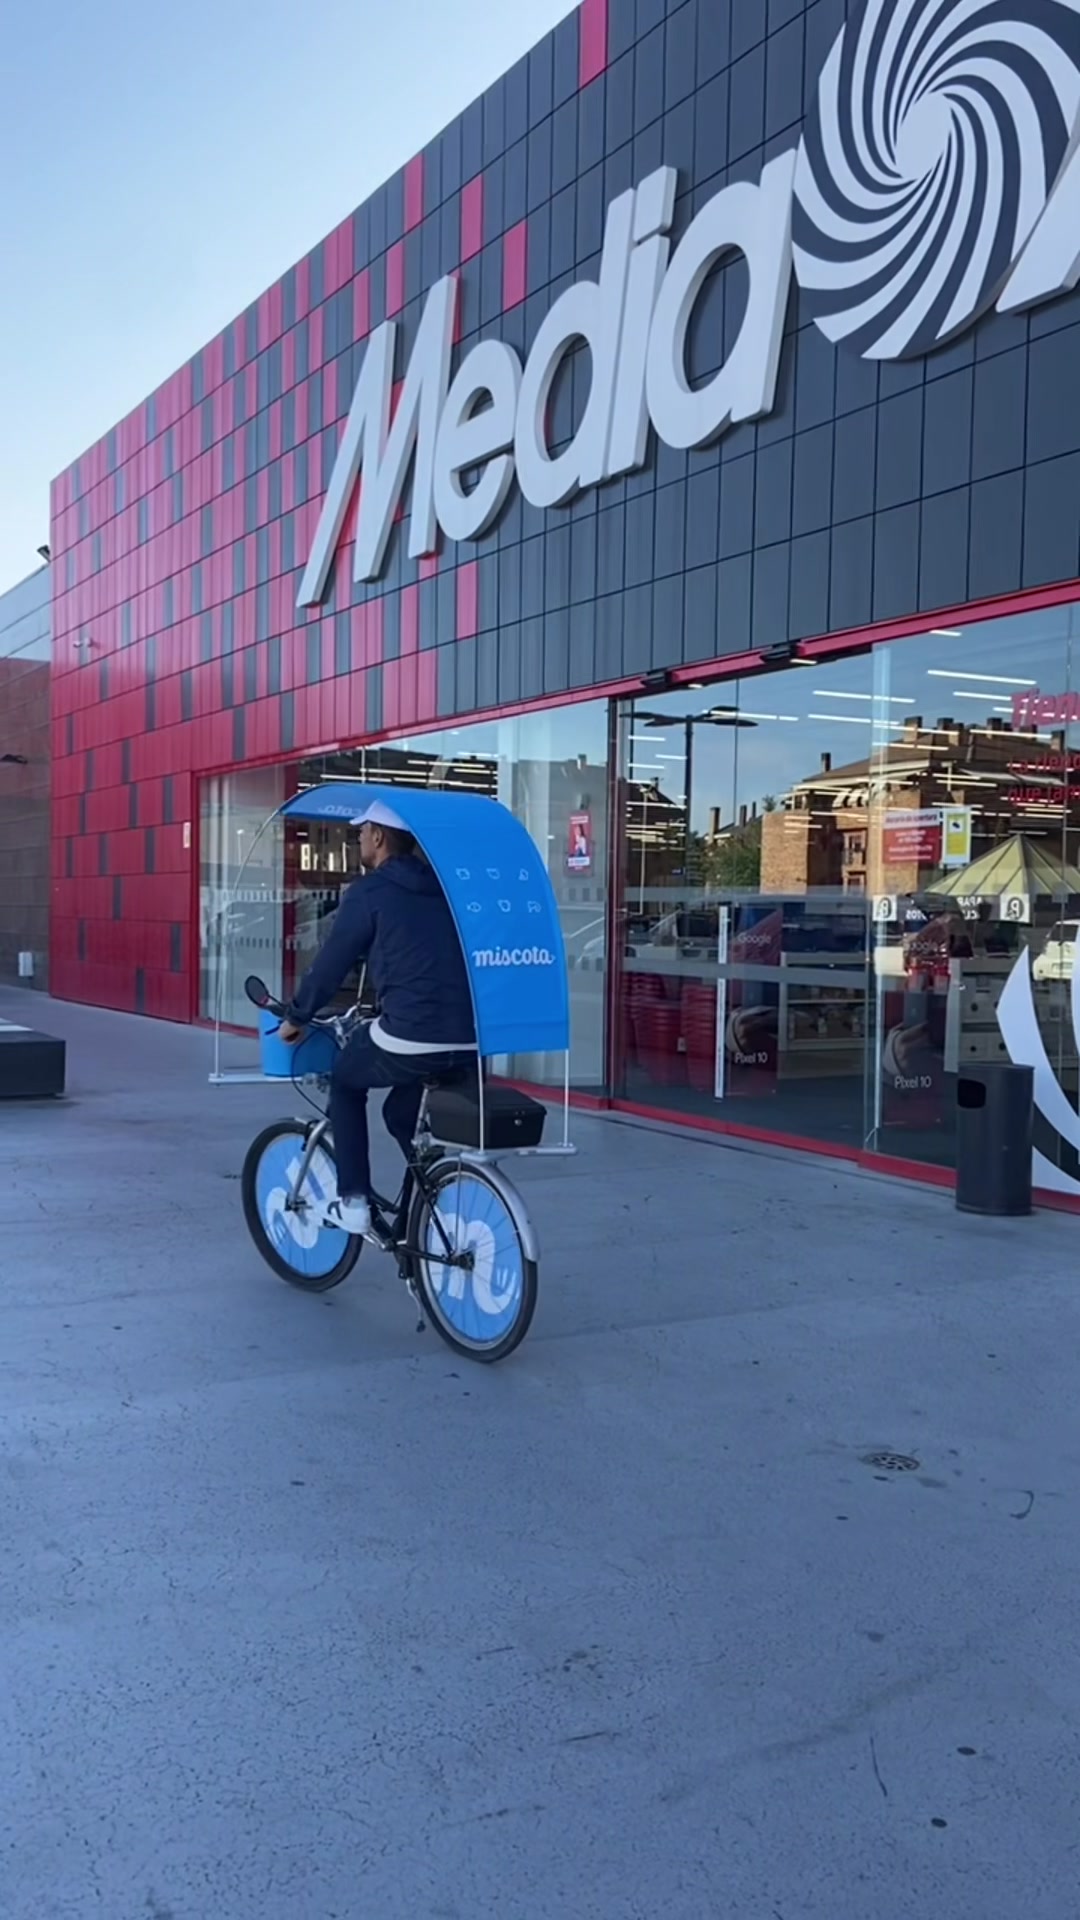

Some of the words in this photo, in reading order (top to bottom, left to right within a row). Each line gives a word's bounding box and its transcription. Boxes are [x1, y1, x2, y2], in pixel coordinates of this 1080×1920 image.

[296, 148, 799, 608] Media
[471, 945, 556, 967] miscota
[734, 1051, 756, 1064] Pixel
[757, 1051, 768, 1063] 10
[894, 1075, 918, 1089] Pixel
[920, 1075, 932, 1088] 10
